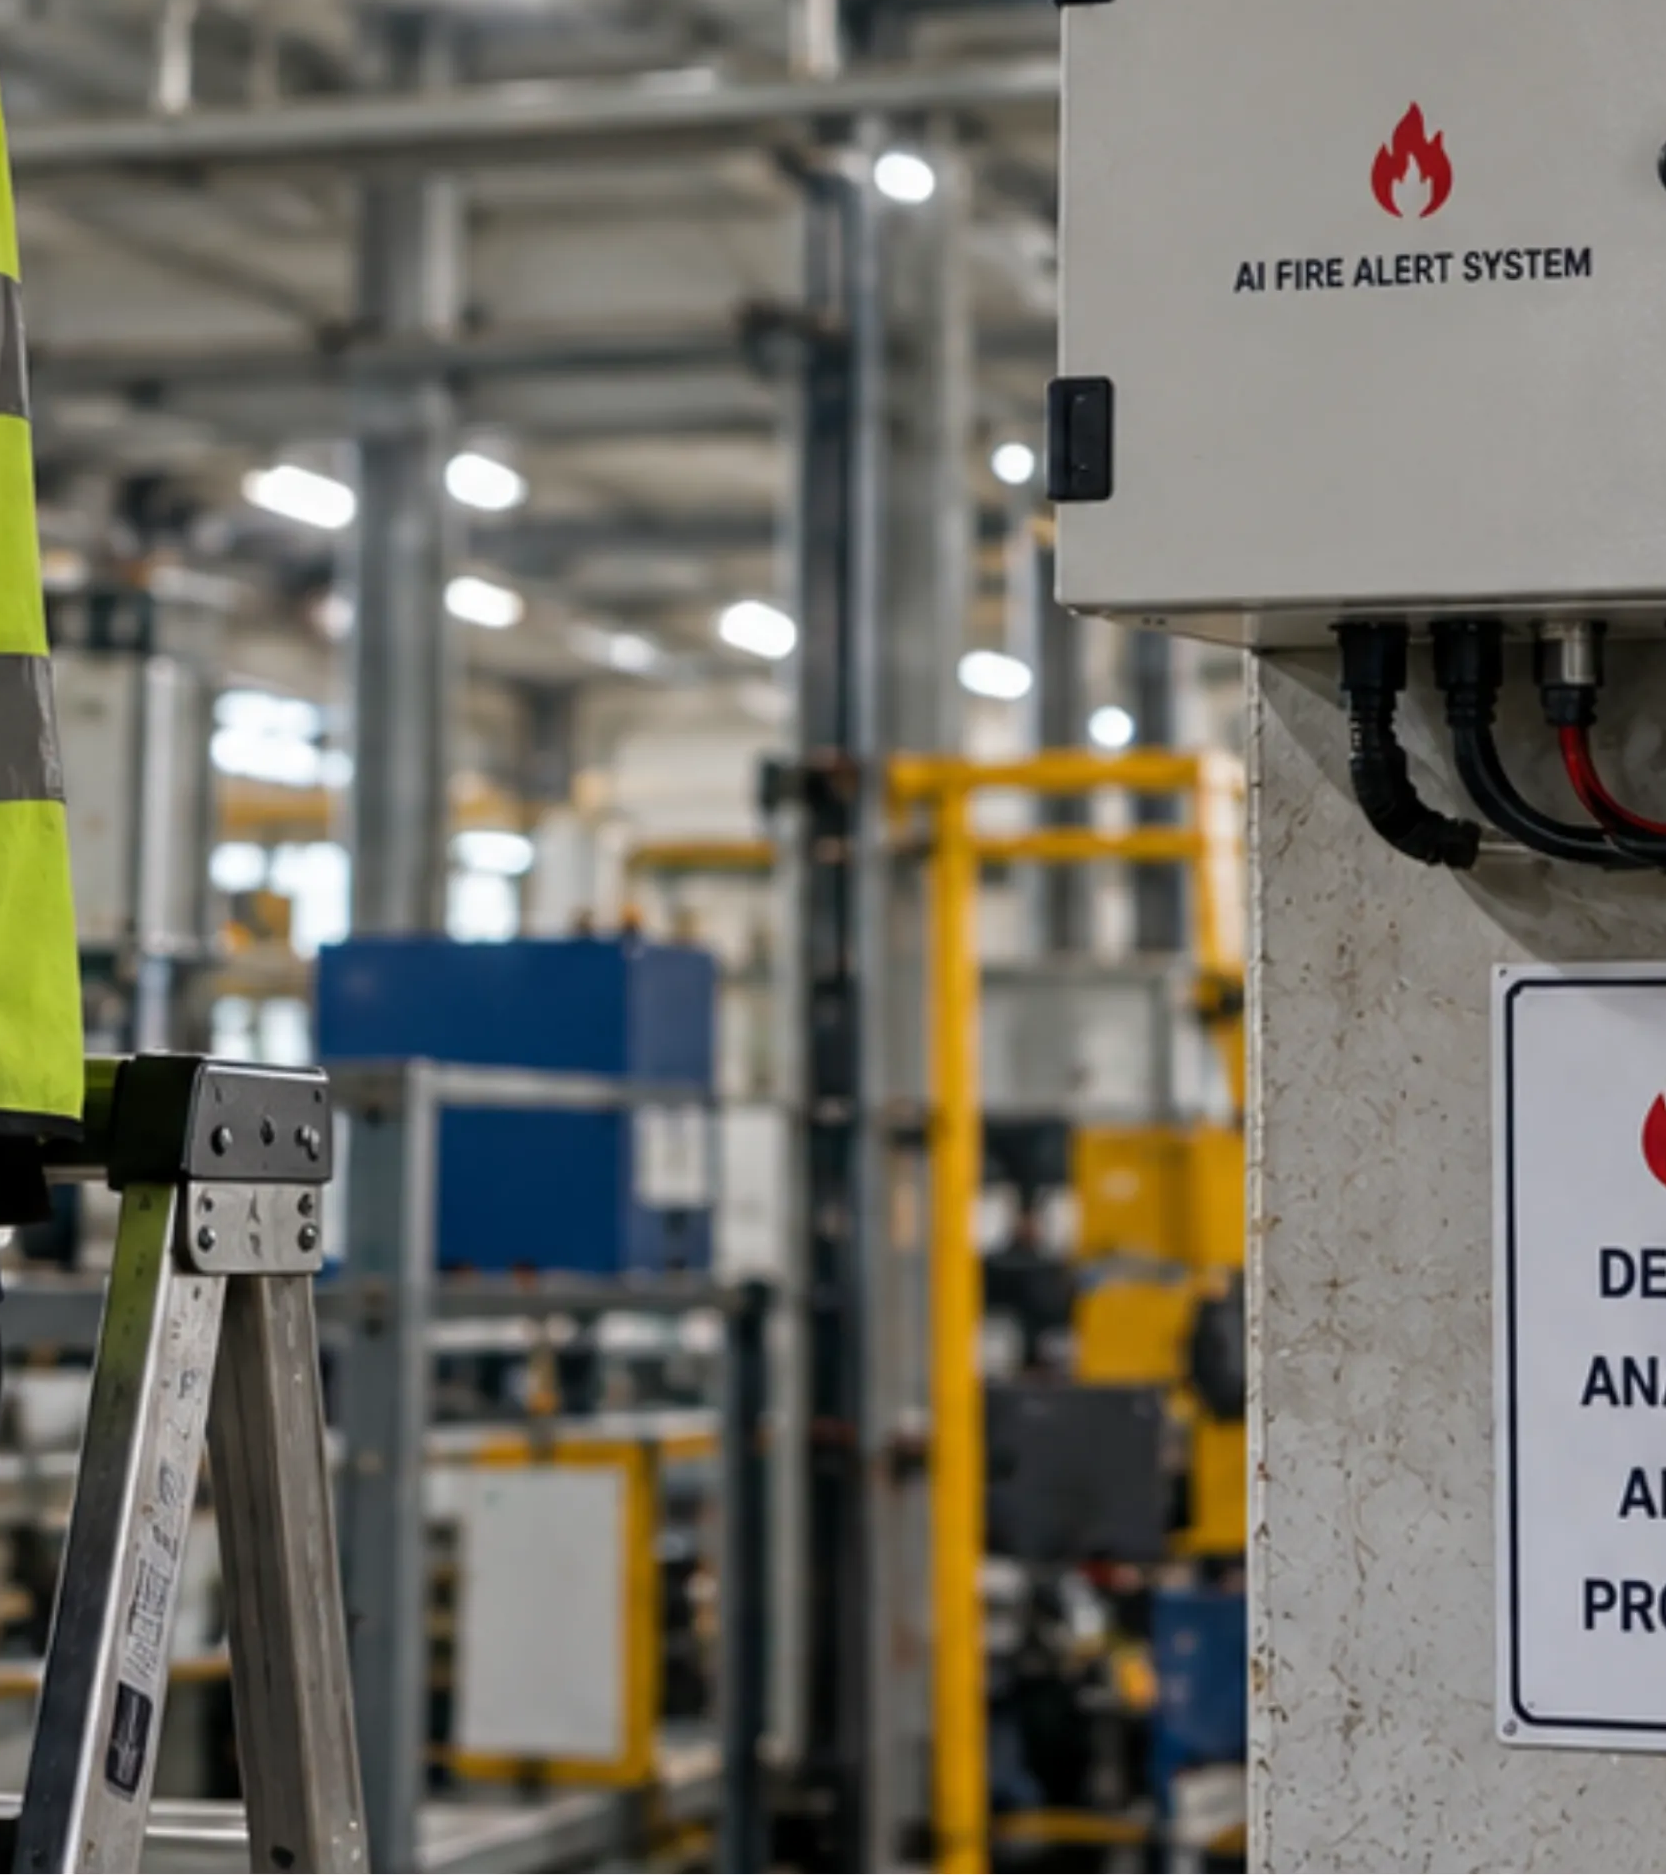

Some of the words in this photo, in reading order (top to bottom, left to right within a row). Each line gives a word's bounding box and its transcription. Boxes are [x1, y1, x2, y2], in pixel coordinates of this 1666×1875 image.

[1234, 260, 1266, 292] AI
[1276, 257, 1344, 291] FIRE
[1353, 252, 1454, 287] ALERT
[1463, 247, 1591, 282] SYSTEM
